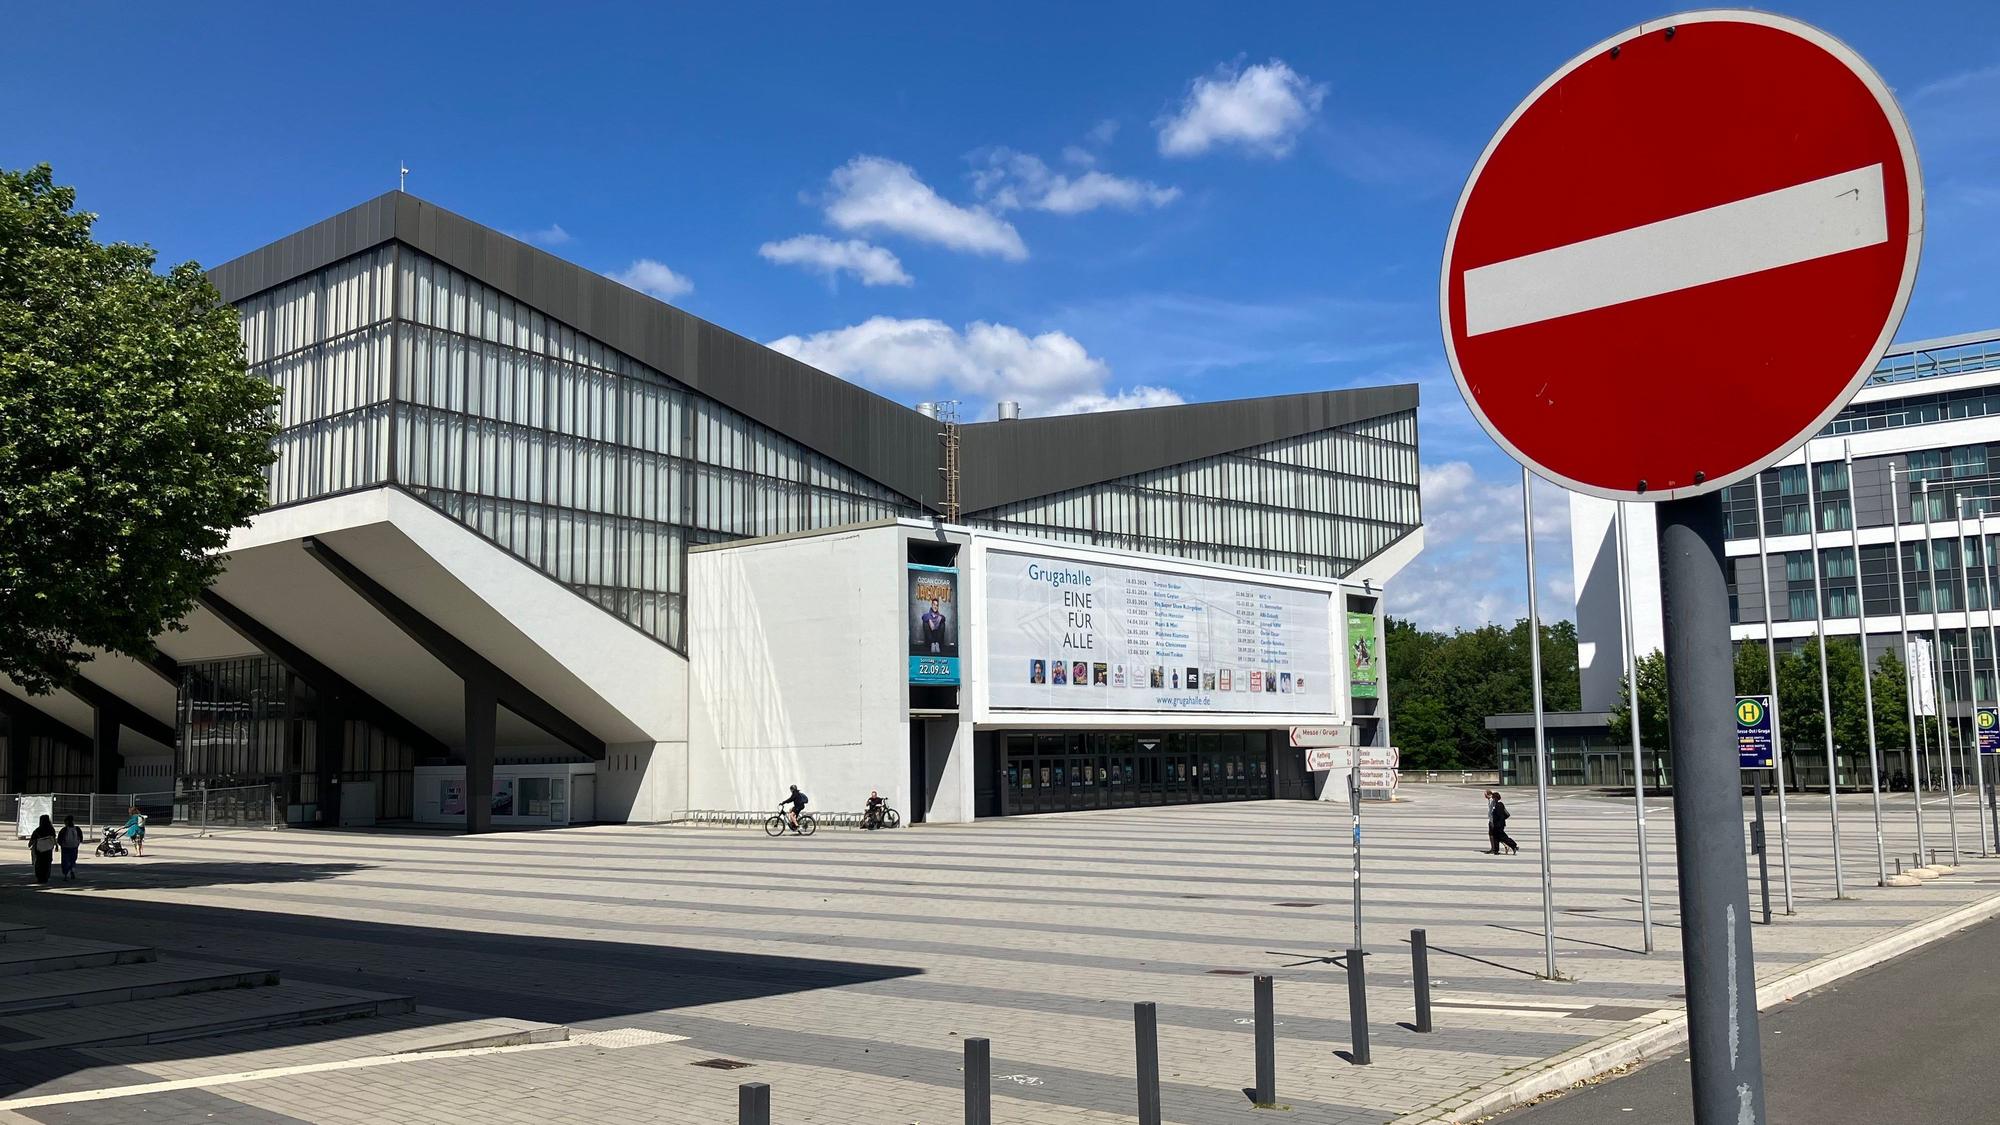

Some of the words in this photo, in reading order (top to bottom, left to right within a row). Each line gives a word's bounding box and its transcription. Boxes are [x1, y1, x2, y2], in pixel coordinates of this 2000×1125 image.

[1028, 564, 1092, 588] Grugahalle
[916, 583, 952, 603] JACKPOT
[1064, 591, 1092, 609] EINE
[1068, 609, 1093, 629] FÜR
[1062, 632, 1093, 650] ALLE
[919, 664, 950, 675] 22.09.24
[1156, 696, 1211, 707] www.grugahalle.de
[1762, 698, 1768, 708] 4
[1743, 704, 1755, 720] H
[1323, 728, 1338, 737] Gruga
